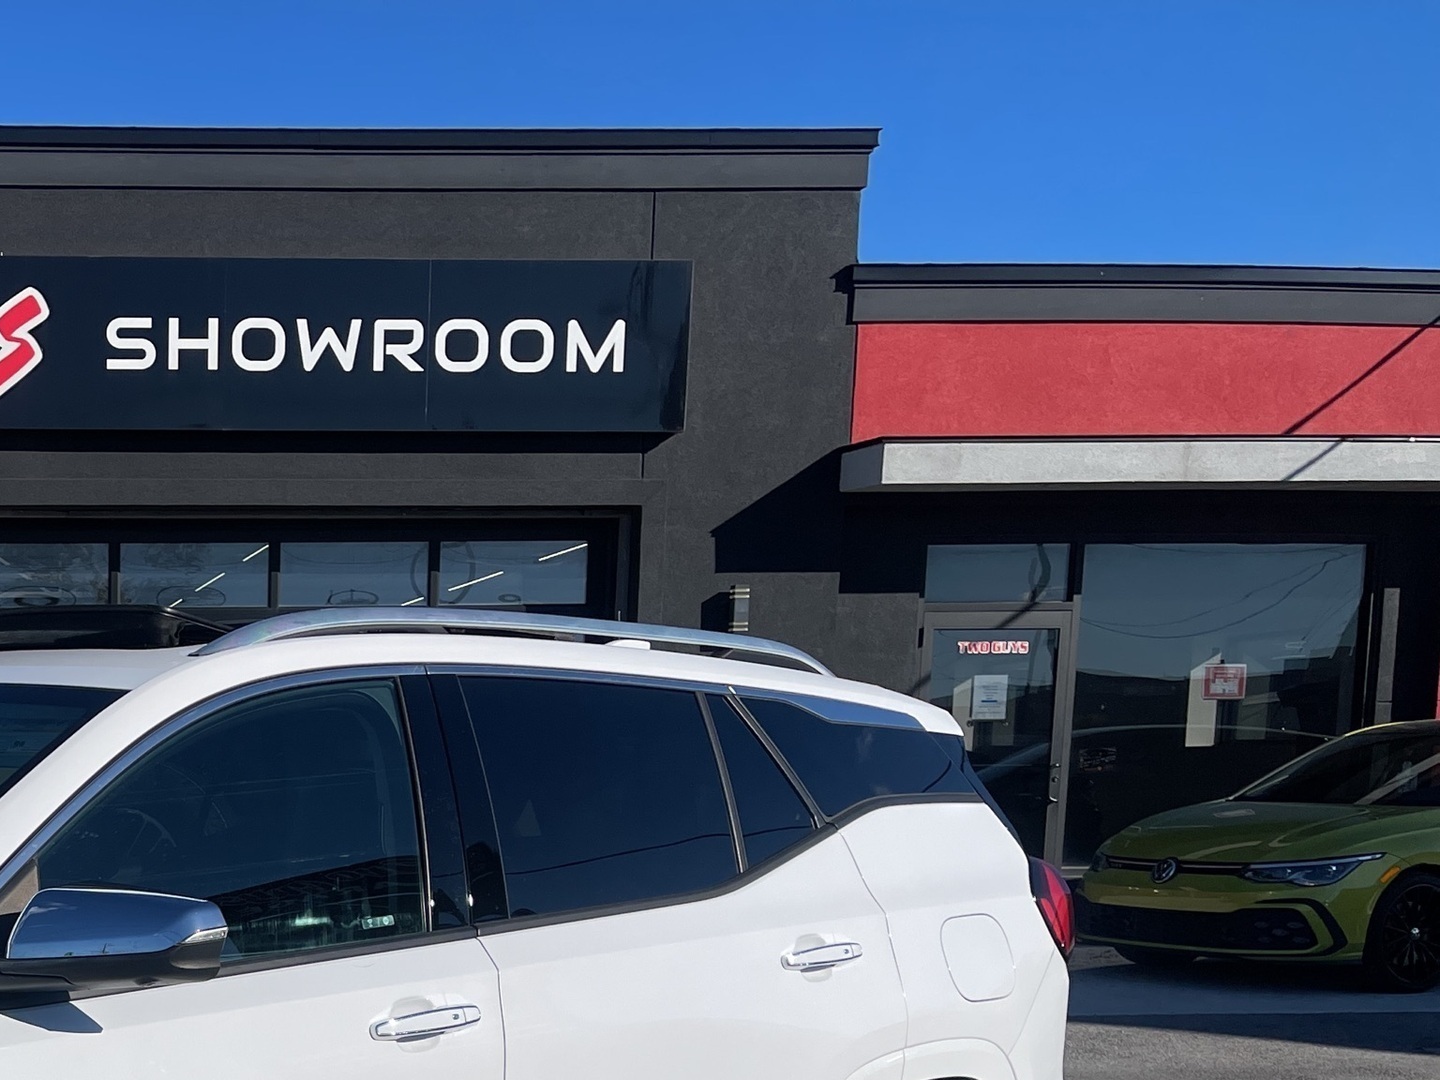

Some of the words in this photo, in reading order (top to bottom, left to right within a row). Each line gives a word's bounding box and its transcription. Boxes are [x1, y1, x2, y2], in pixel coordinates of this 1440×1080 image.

[107, 318, 627, 373] SHOWROOM
[958, 641, 990, 654] TWO
[991, 641, 1029, 654] GUYS
